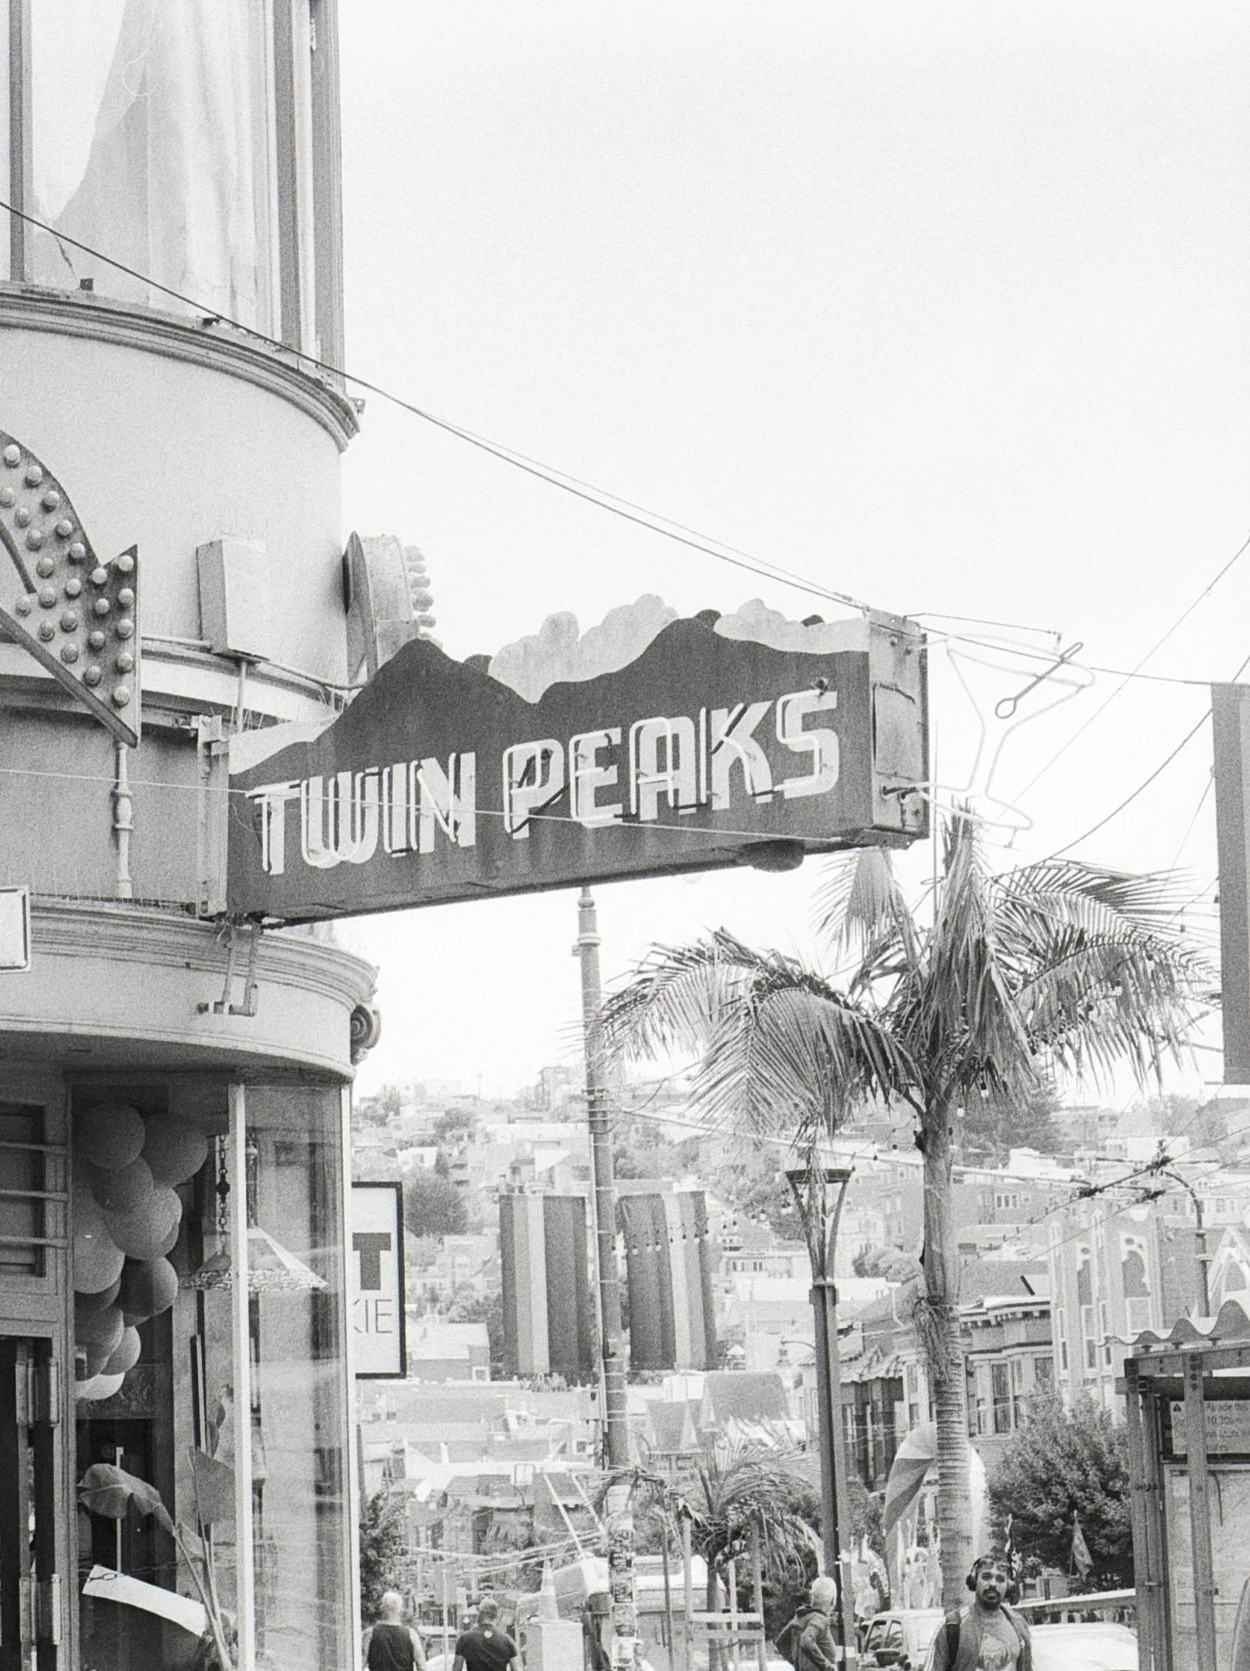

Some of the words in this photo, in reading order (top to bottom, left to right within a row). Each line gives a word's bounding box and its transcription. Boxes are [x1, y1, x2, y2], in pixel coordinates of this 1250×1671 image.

[246, 751, 476, 875] TWIN
[502, 689, 841, 839] PEAKS
[353, 1298, 393, 1334] IE
